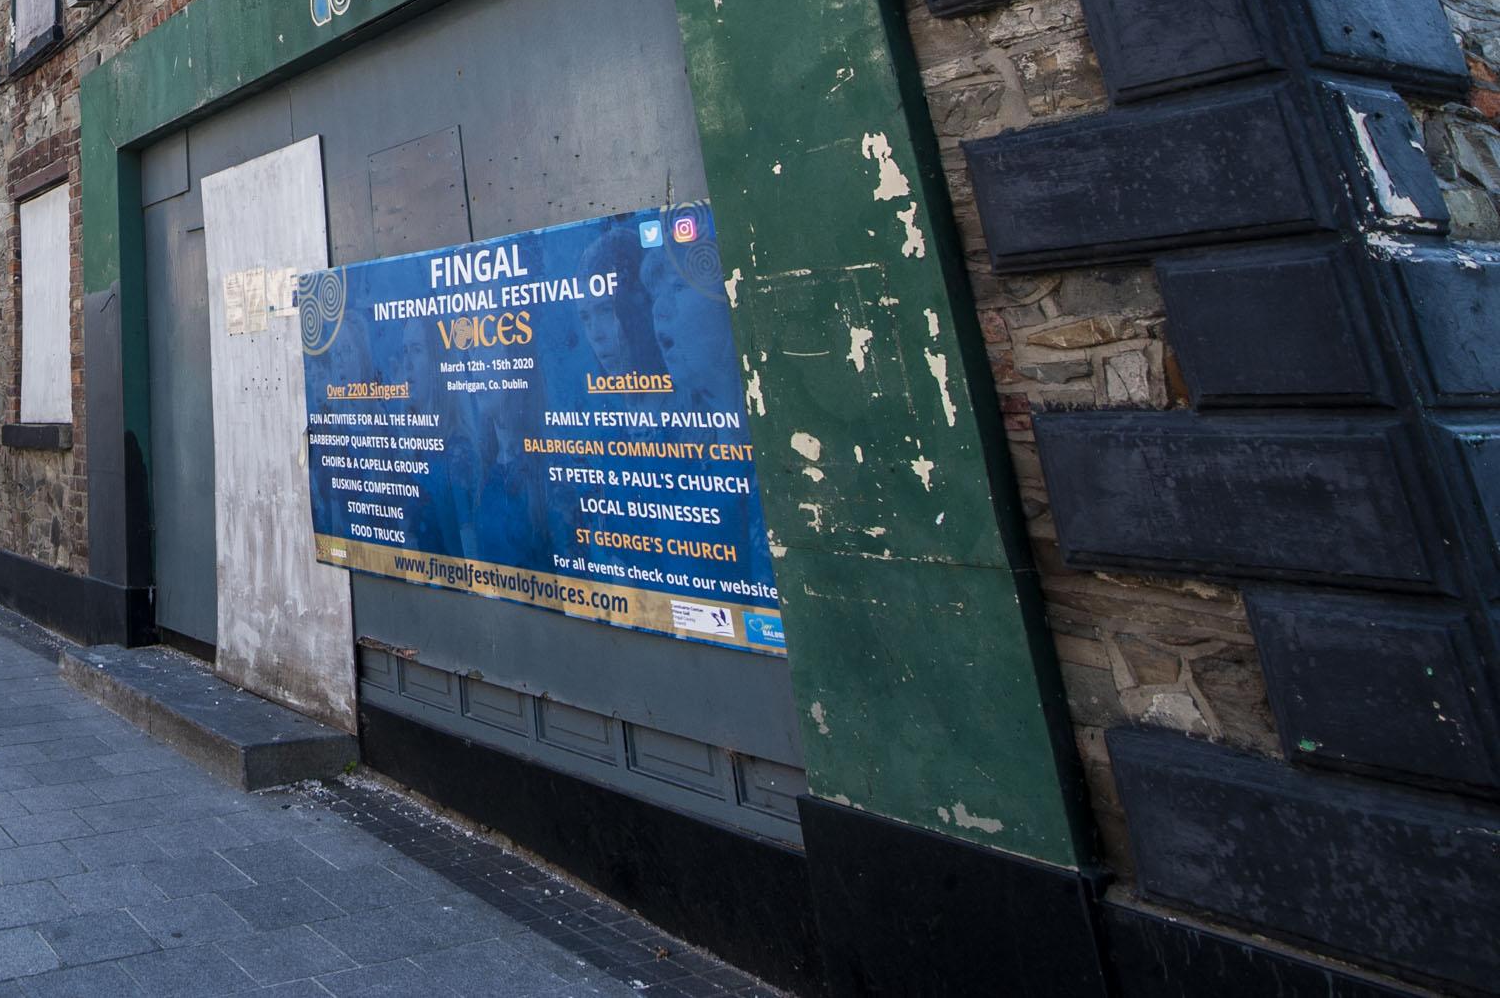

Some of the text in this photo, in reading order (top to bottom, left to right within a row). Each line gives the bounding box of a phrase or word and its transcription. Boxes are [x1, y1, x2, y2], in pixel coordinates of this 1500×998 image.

[430, 244, 528, 289] FINGAL
[374, 272, 618, 321] INTERNATIONAL FESTIVAL OF
[437, 310, 533, 351] VOICES
[440, 360, 465, 373] March
[467, 360, 485, 372] 12th
[491, 359, 511, 371] 15th
[512, 357, 534, 370] 2020
[326, 381, 410, 400] Over 2200 Singers!
[447, 378, 528, 393] Balbriggan, Co. Dublin
[586, 371, 673, 392] Locations
[310, 413, 440, 427] FUN ACTIVITIES FOR ALL THE FAMILY
[545, 411, 740, 429] FAMILY FESTIVAL PAVILION
[309, 433, 445, 451] BARBERSHOP QUARTETS & CHORUSES
[523, 438, 754, 461] BALBRIGGAN COMMUNITY CENT
[321, 455, 430, 475] CHOIRS & A CAPELLA GROUPS
[331, 477, 420, 498] BUSKING COMPETITION
[549, 466, 750, 494] ST PETER & PAUL'S CHURCH
[348, 501, 404, 520] STORYTELLING
[580, 497, 721, 525] LOCAL BUSINESSES
[350, 523, 406, 544] FOOD TRUCKS
[576, 528, 737, 563] ST GEORGE'S CHURCH
[394, 555, 629, 614] www.fingalfestivalofvoices.com
[553, 554, 779, 600] For all events check out our website
